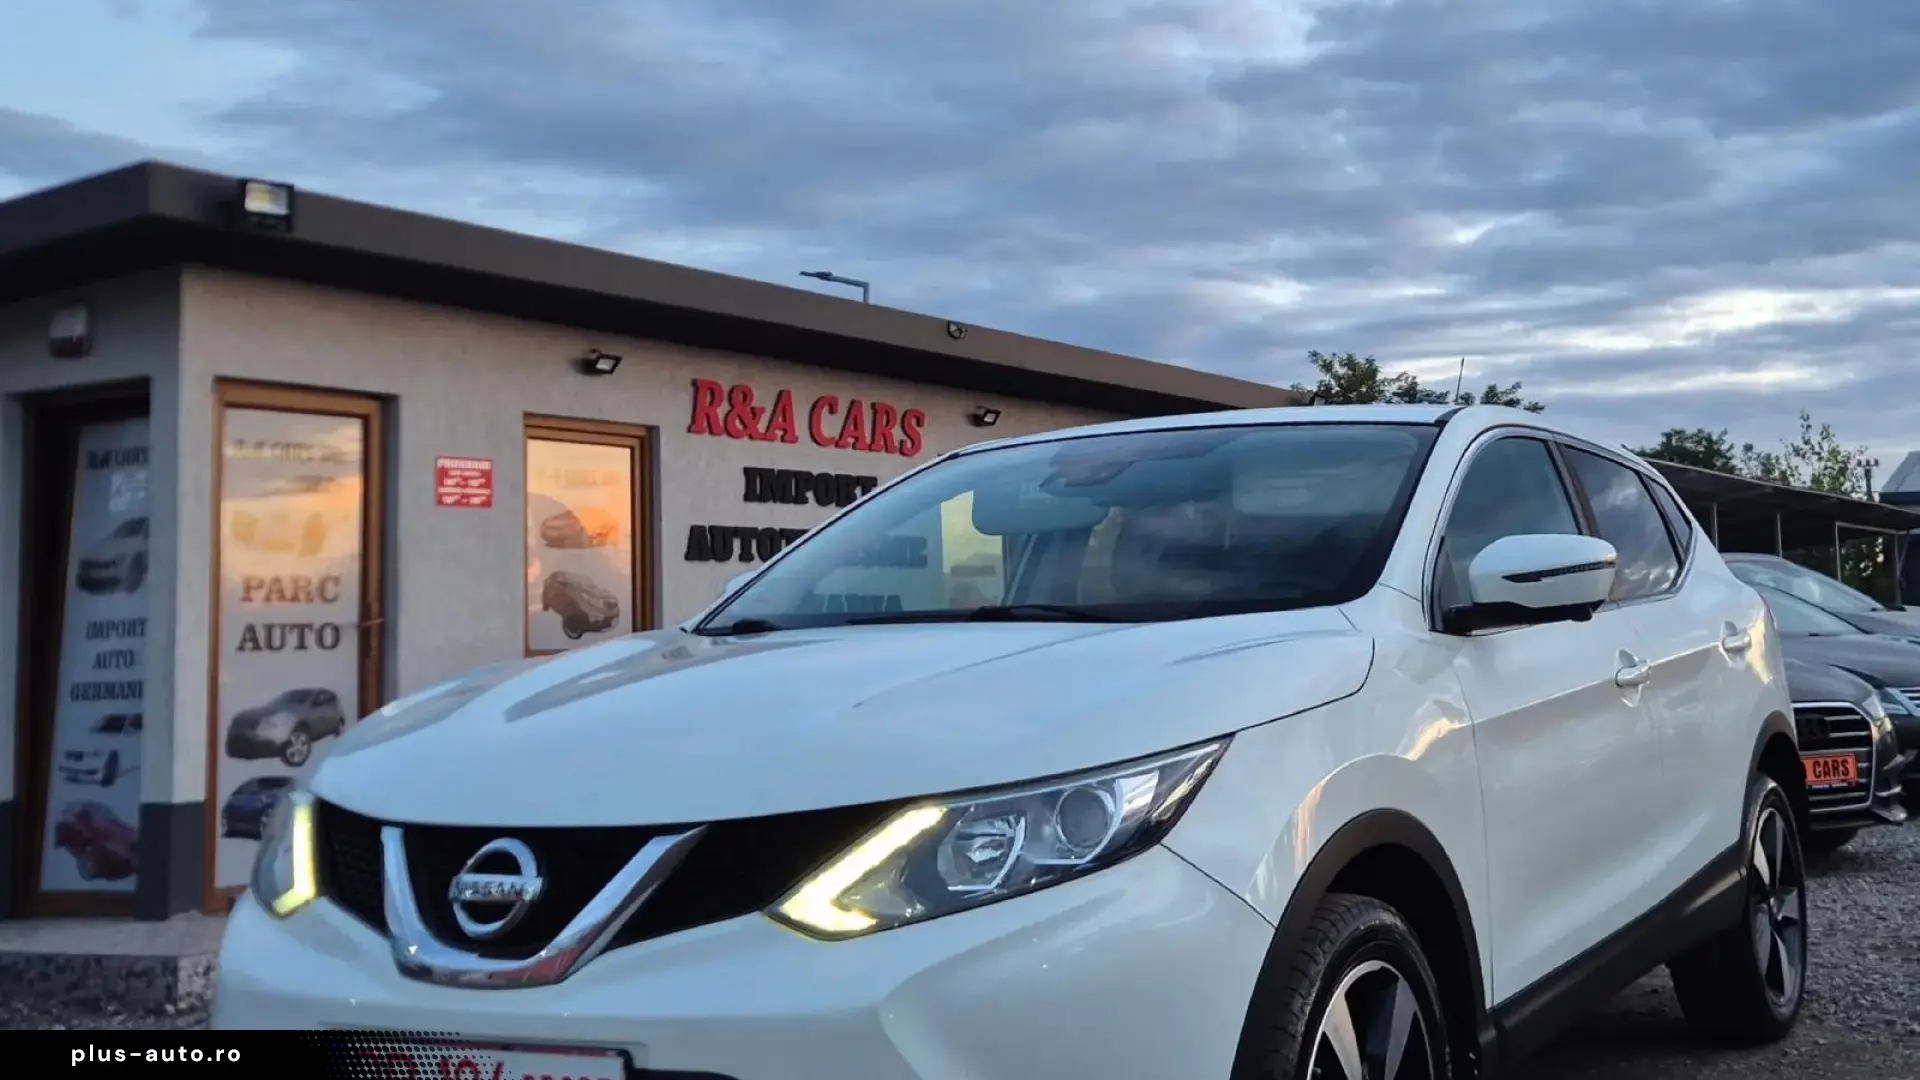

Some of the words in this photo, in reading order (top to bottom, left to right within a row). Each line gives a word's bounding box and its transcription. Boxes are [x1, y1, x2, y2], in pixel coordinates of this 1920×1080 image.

[687, 378, 799, 444] R&A
[809, 395, 926, 456] CARS
[743, 467, 878, 508] IMPORT
[239, 575, 341, 604] PARC
[85, 617, 149, 640] IMPORT
[236, 622, 341, 652] AUTO
[92, 649, 135, 669] AUTO
[1812, 758, 1850, 779] CARS
